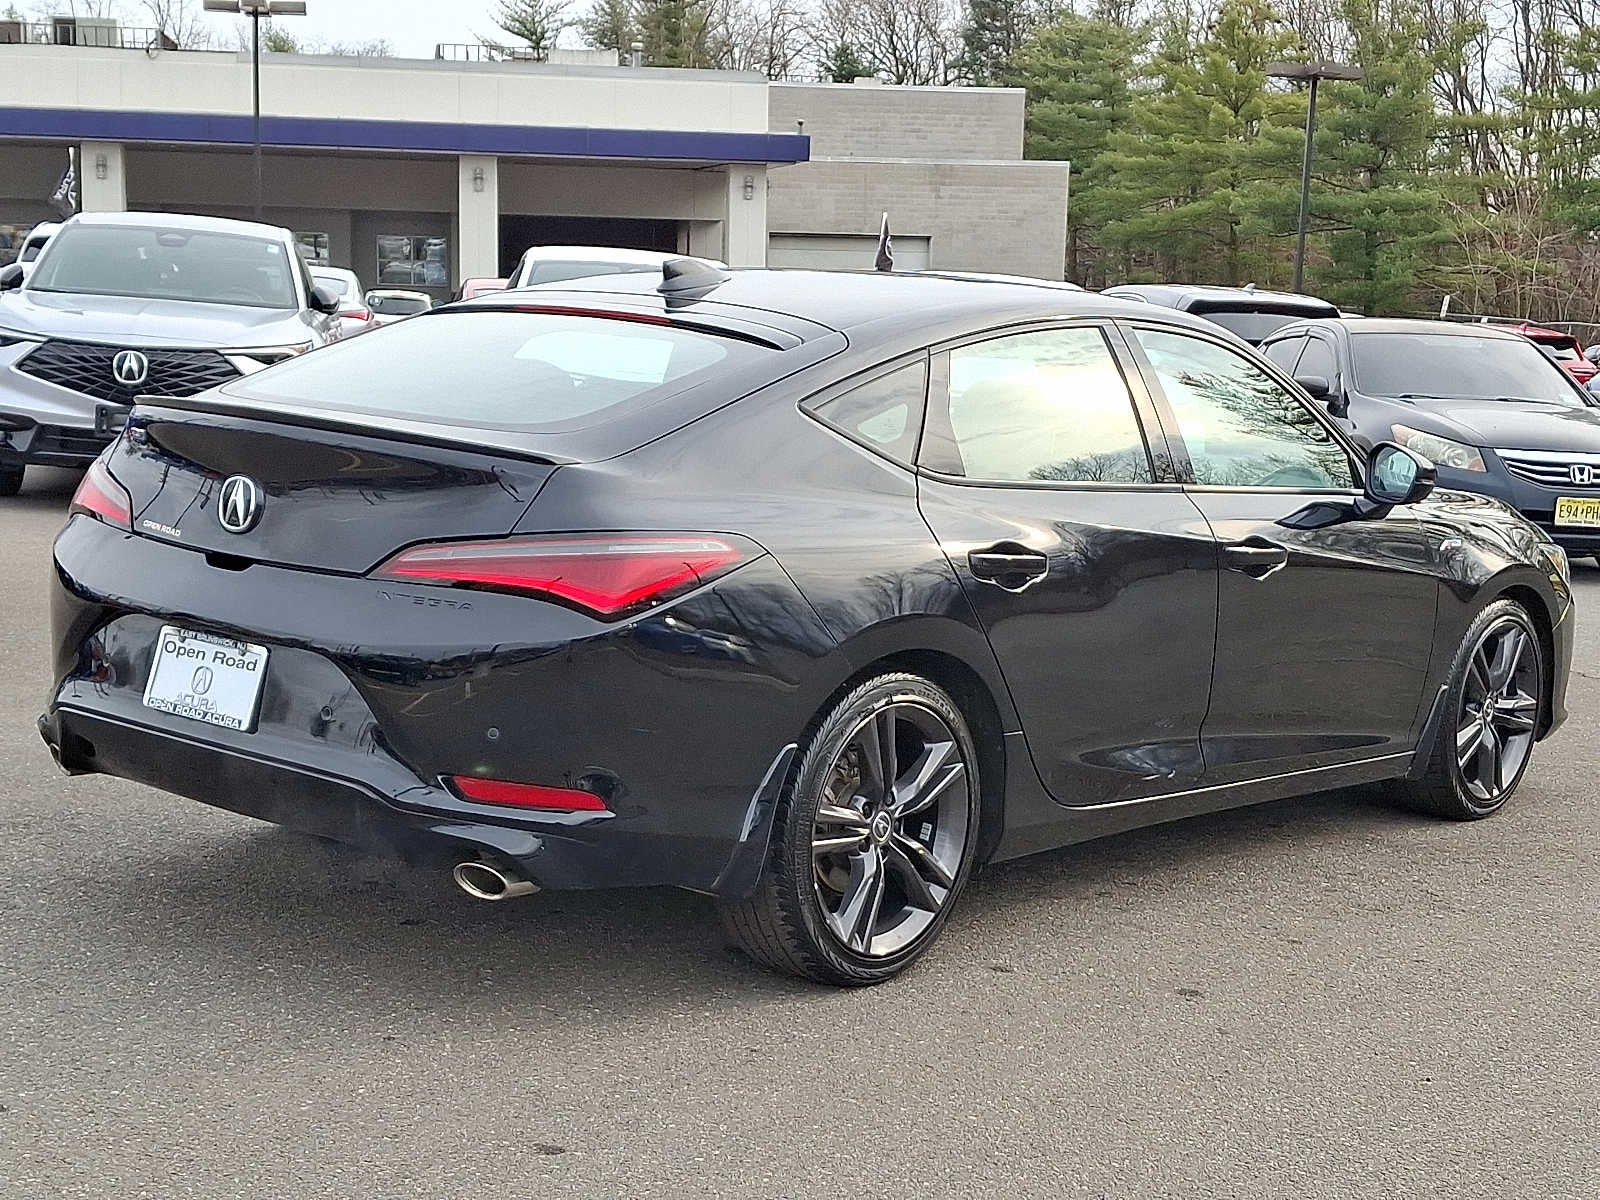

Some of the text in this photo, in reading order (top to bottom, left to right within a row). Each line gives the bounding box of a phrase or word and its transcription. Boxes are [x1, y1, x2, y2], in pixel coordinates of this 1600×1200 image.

[1585, 505, 1600, 520] PH
[161, 524, 181, 536] ROAD
[376, 590, 474, 611] INTEGRA
[164, 640, 258, 672] Open Road
[174, 691, 218, 713] ACURA
[148, 697, 240, 729] OPEN ROAD ACURA
